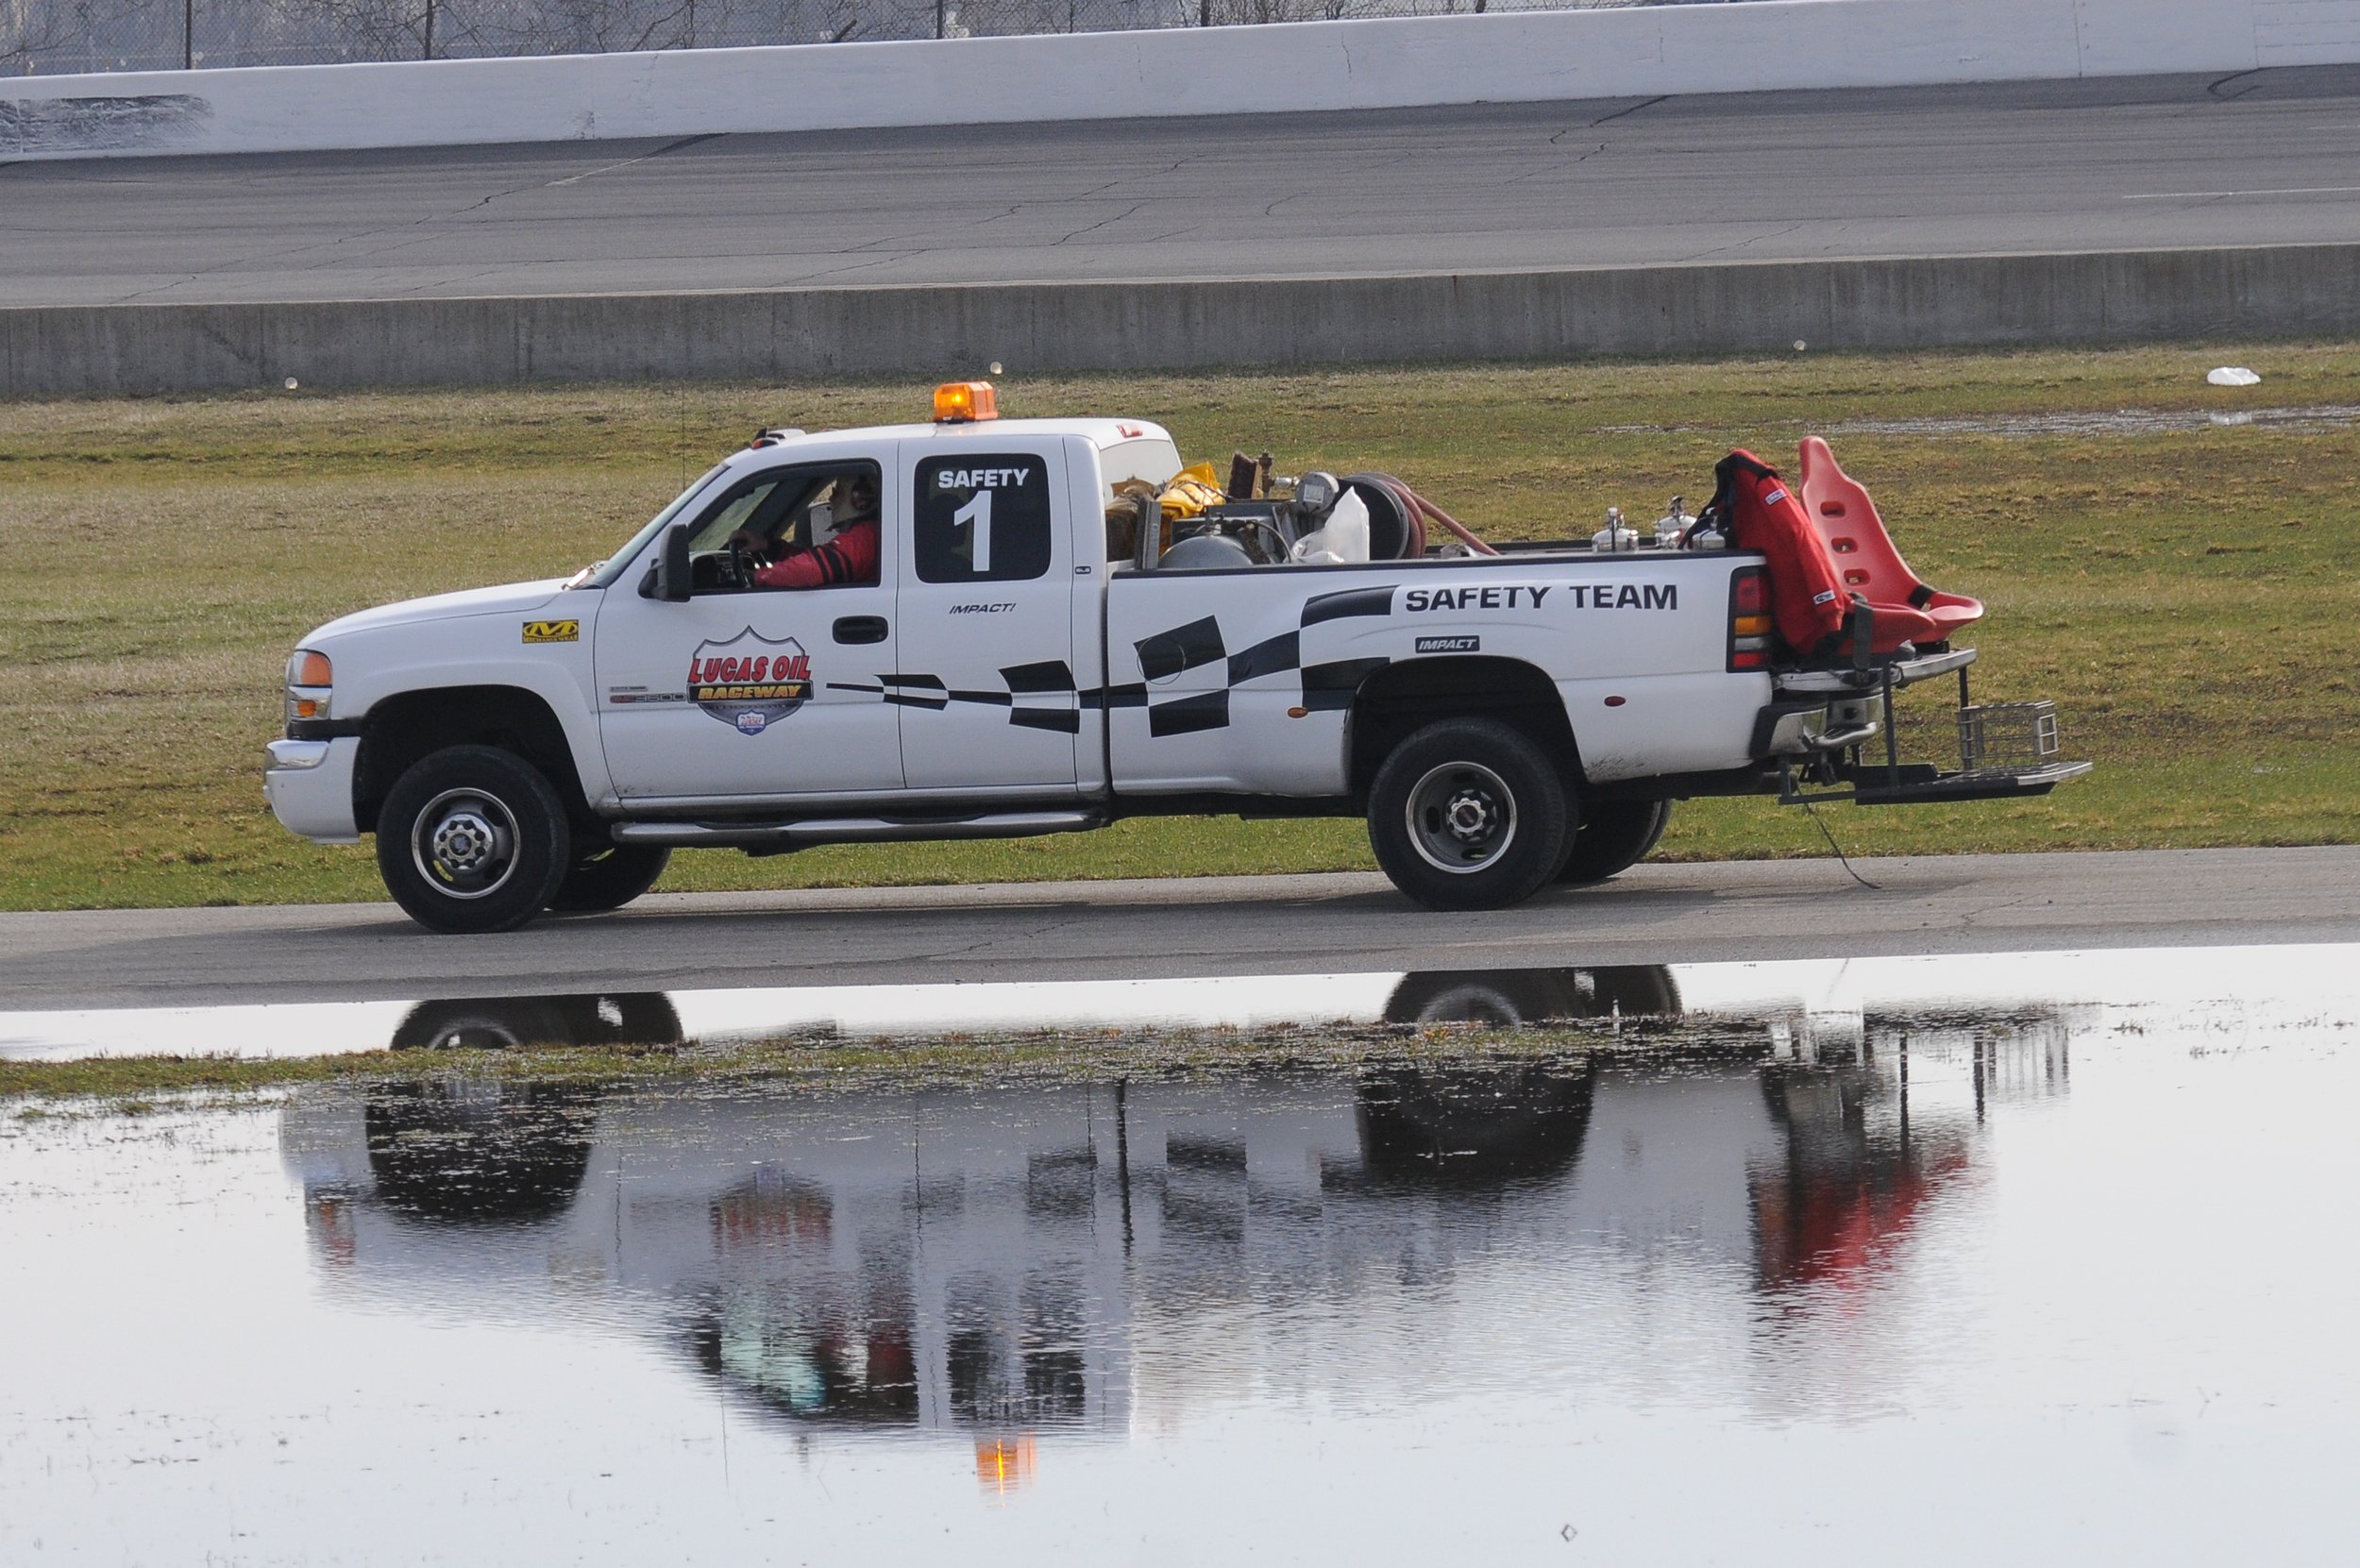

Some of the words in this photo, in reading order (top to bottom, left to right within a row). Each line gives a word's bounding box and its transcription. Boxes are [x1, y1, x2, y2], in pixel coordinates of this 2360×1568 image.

[937, 468, 1030, 489] SAFETY
[953, 490, 992, 572] 1
[949, 602, 1017, 615] IMPACT!
[1406, 586, 1553, 612] SAFETY
[1569, 584, 1677, 610] TEAM
[1418, 638, 1476, 650] IMPACT
[687, 656, 769, 684] LUCAS
[771, 655, 812, 681] OIL
[697, 684, 802, 700] RACEWAY
